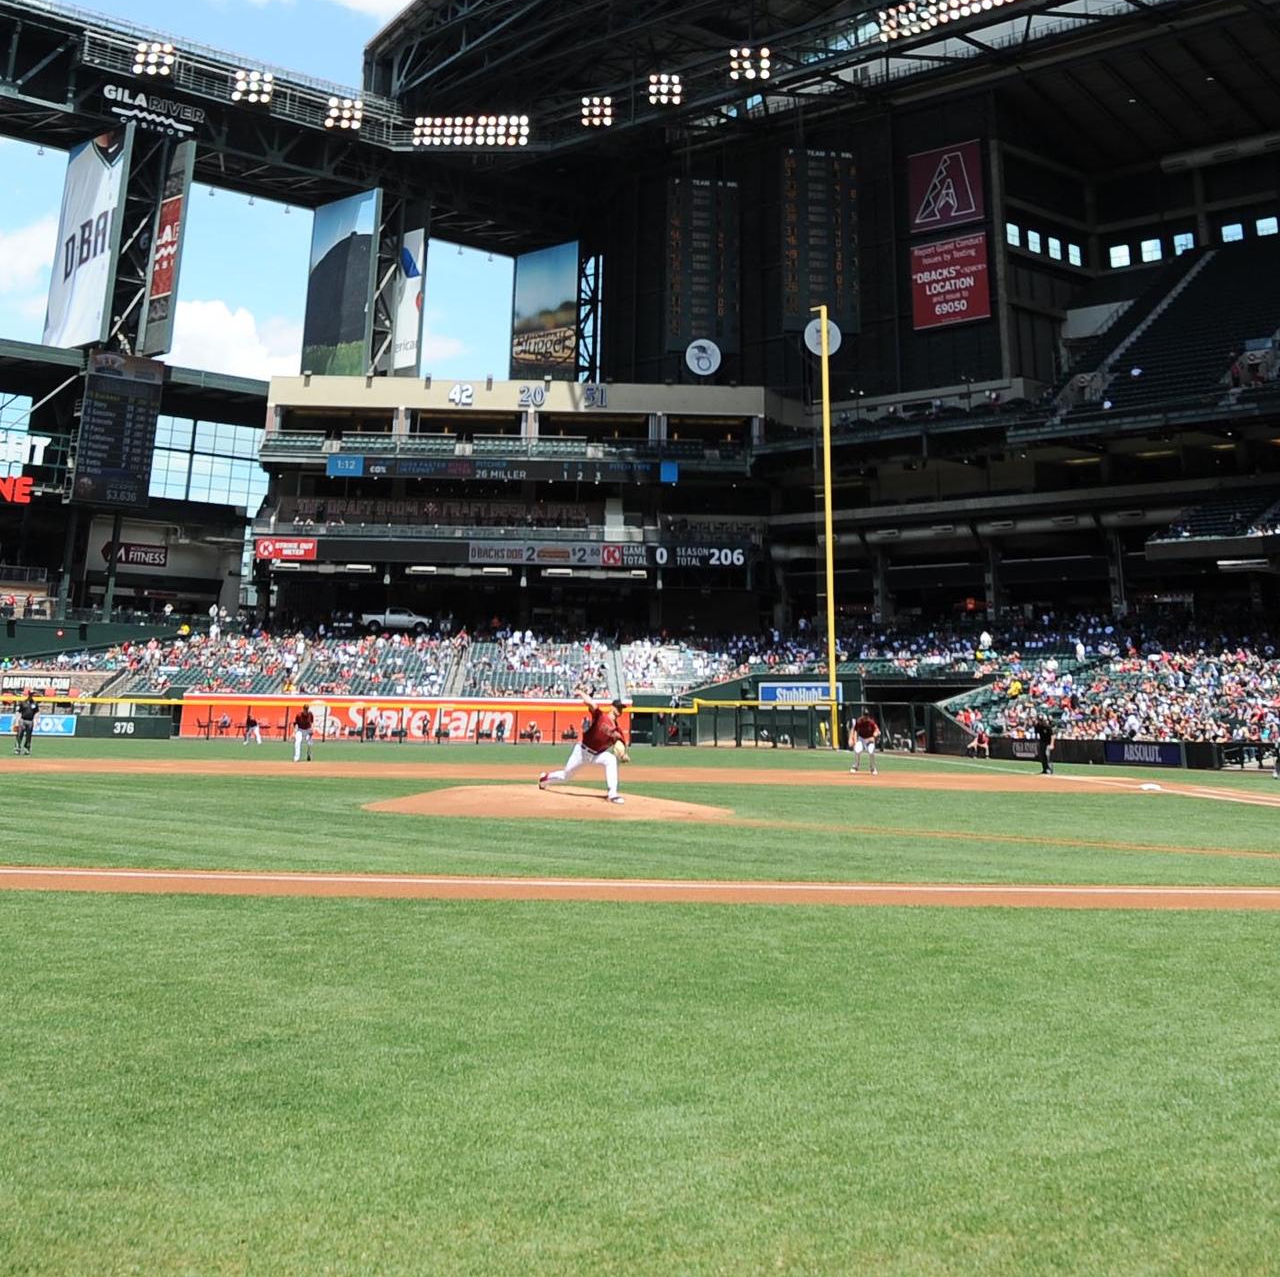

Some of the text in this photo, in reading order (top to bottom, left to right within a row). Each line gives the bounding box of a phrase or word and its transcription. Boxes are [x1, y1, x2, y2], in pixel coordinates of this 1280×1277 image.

[104, 84, 204, 122] GILA RIVER
[120, 117, 183, 137] CASINOS
[926, 276, 974, 295] LOCATION
[935, 300, 967, 315] 69050
[448, 384, 473, 405] 42
[519, 386, 545, 407] 20
[584, 386, 607, 408] 51
[336, 460, 355, 469] 1:12
[476, 470, 489, 479] 26
[490, 470, 526, 480] MILLER
[577, 472, 583, 480] 2
[129, 552, 165, 564] FITNESS
[526, 546, 535, 562] 2
[623, 546, 646, 555] GAME
[623, 548, 667, 564] TOTAL 0
[676, 548, 743, 565] SEASON 206
[676, 557, 700, 566] TOTAL
[3, 676, 70, 690] RAMTRUCKS.COM
[349, 702, 514, 737] State Farm
[1123, 744, 1162, 763] ABSOLUT.
